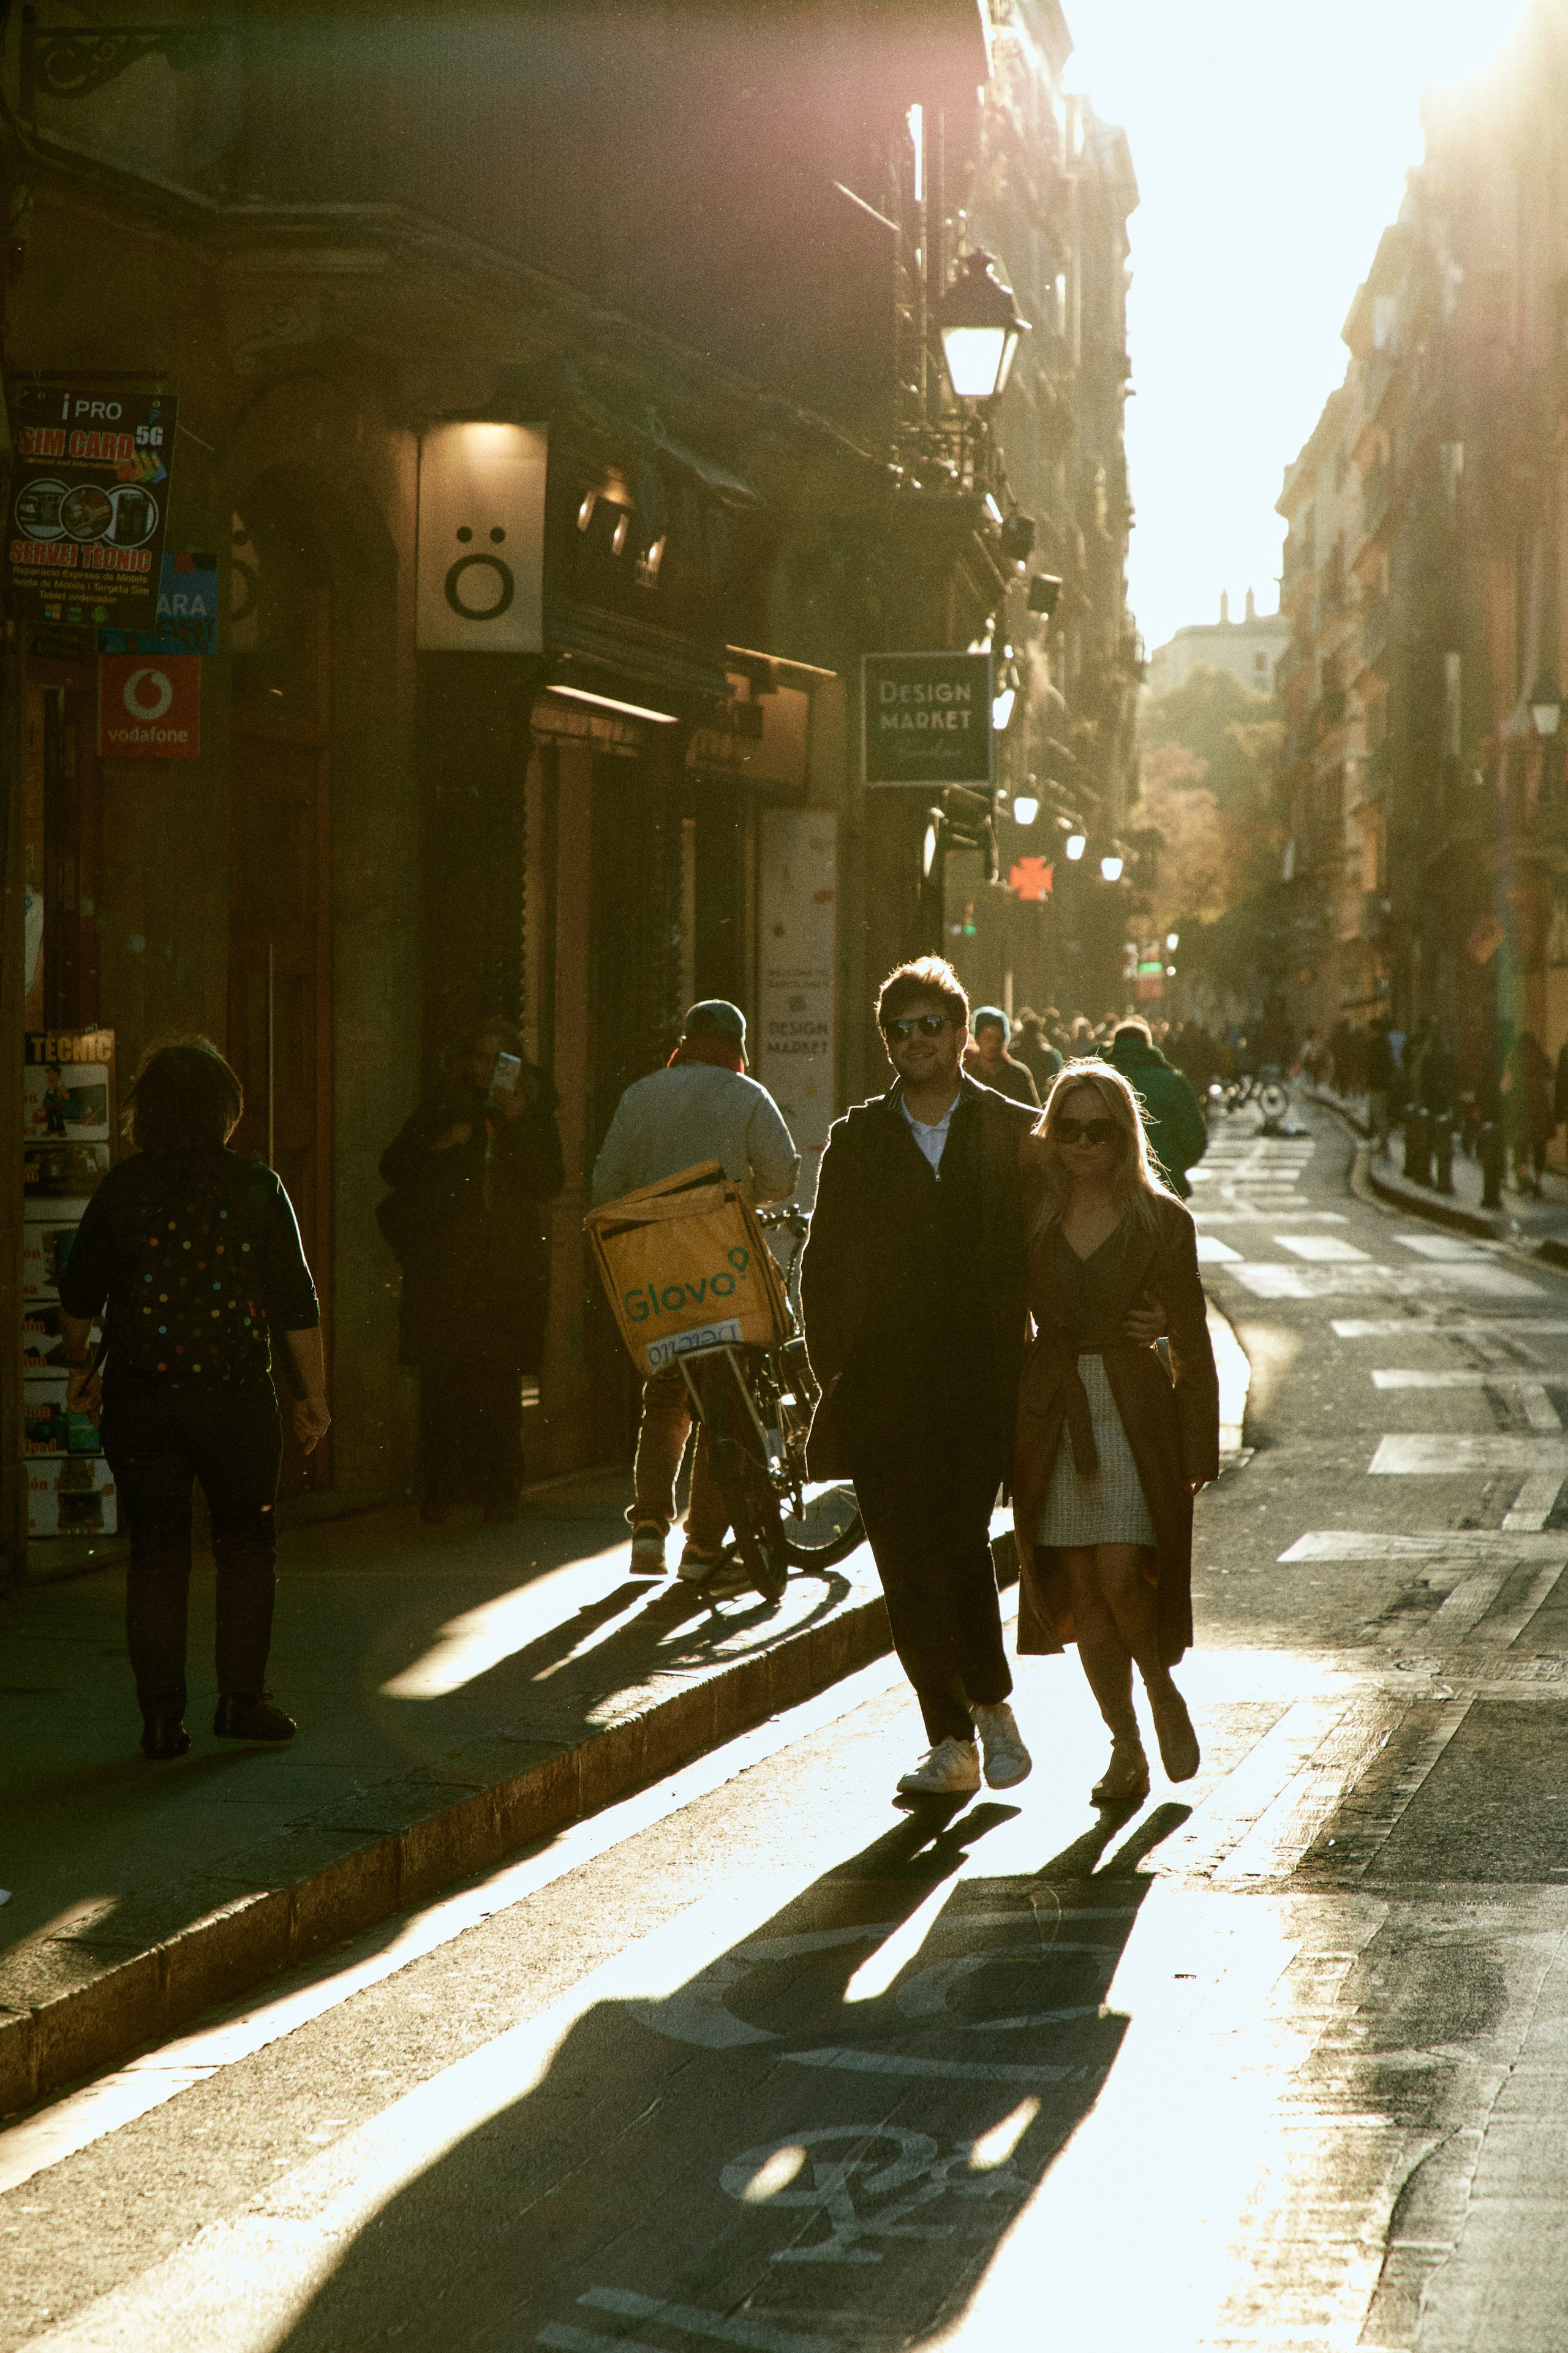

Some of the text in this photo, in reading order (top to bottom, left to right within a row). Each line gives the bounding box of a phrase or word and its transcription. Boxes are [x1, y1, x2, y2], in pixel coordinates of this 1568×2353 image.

[75, 400, 123, 420] PRO
[19, 426, 135, 461] SIM CARD
[135, 425, 164, 445] 5G
[10, 540, 152, 573] SERVEI TÈCNIC
[103, 572, 115, 581] de
[39, 590, 118, 604] Tablet ordenador
[93, 583, 129, 594] Targeta
[131, 585, 149, 595] Sim
[880, 710, 973, 730] MARKET
[108, 728, 188, 742] vodafone
[767, 1021, 828, 1035] DESIGN
[31, 1031, 111, 1063] TÈCNIC
[624, 1272, 736, 1323] Glovo
